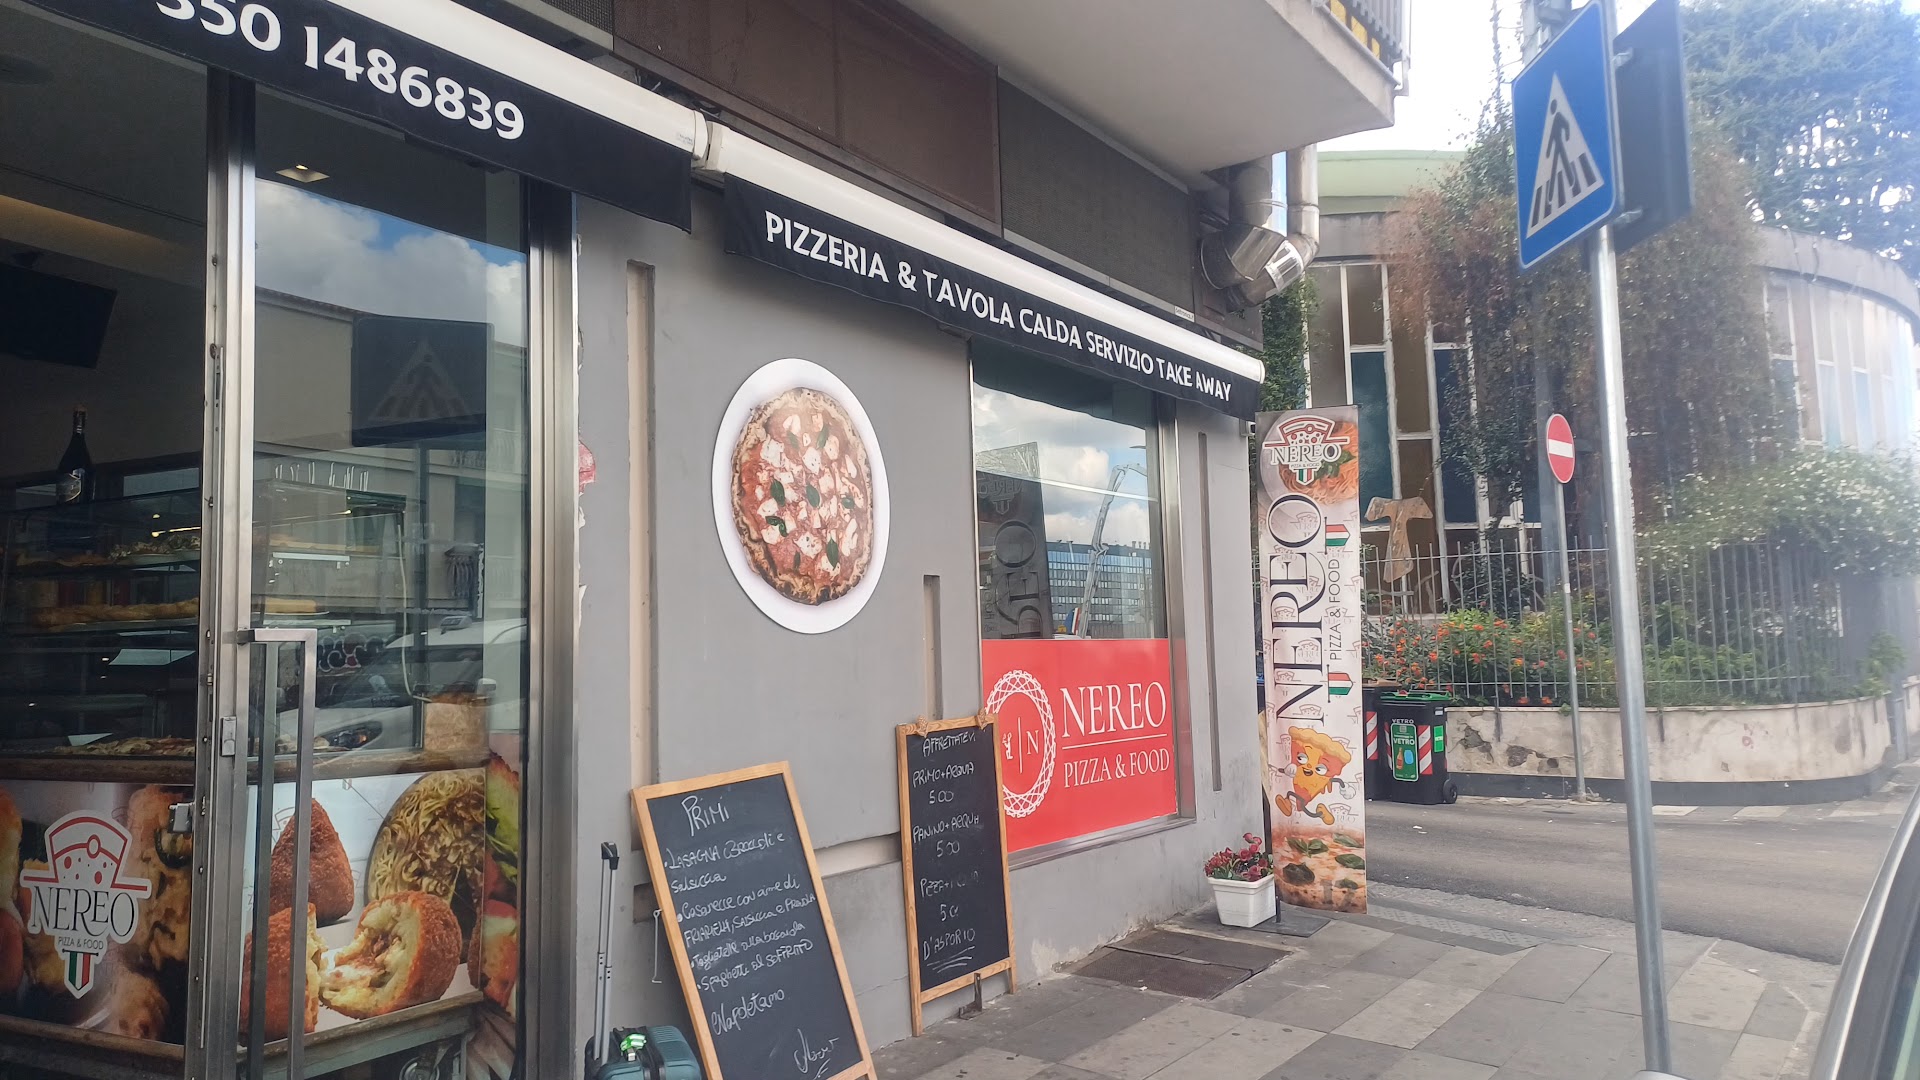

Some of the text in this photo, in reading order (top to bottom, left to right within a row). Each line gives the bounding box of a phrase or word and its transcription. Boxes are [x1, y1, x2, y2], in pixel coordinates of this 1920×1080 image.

[304, 26, 525, 141] 1486839
[765, 210, 1232, 402] PIZZERIA & TAVOLA CALDA SERVIZIO TAKE AWAY
[1272, 443, 1340, 463] NEREO
[1328, 558, 1341, 604] FOOD
[1268, 494, 1326, 726] NEREO
[1330, 608, 1341, 618] &
[1330, 625, 1342, 661] PIZZA
[1060, 681, 1167, 738] NEREO
[1026, 730, 1040, 754] N
[1063, 748, 1170, 788] PIZZA & FOOD
[783, 873, 801, 890] di
[32, 886, 135, 937] NEREO
[58, 936, 74, 946] PIZZA
[84, 939, 104, 950] FOOD
